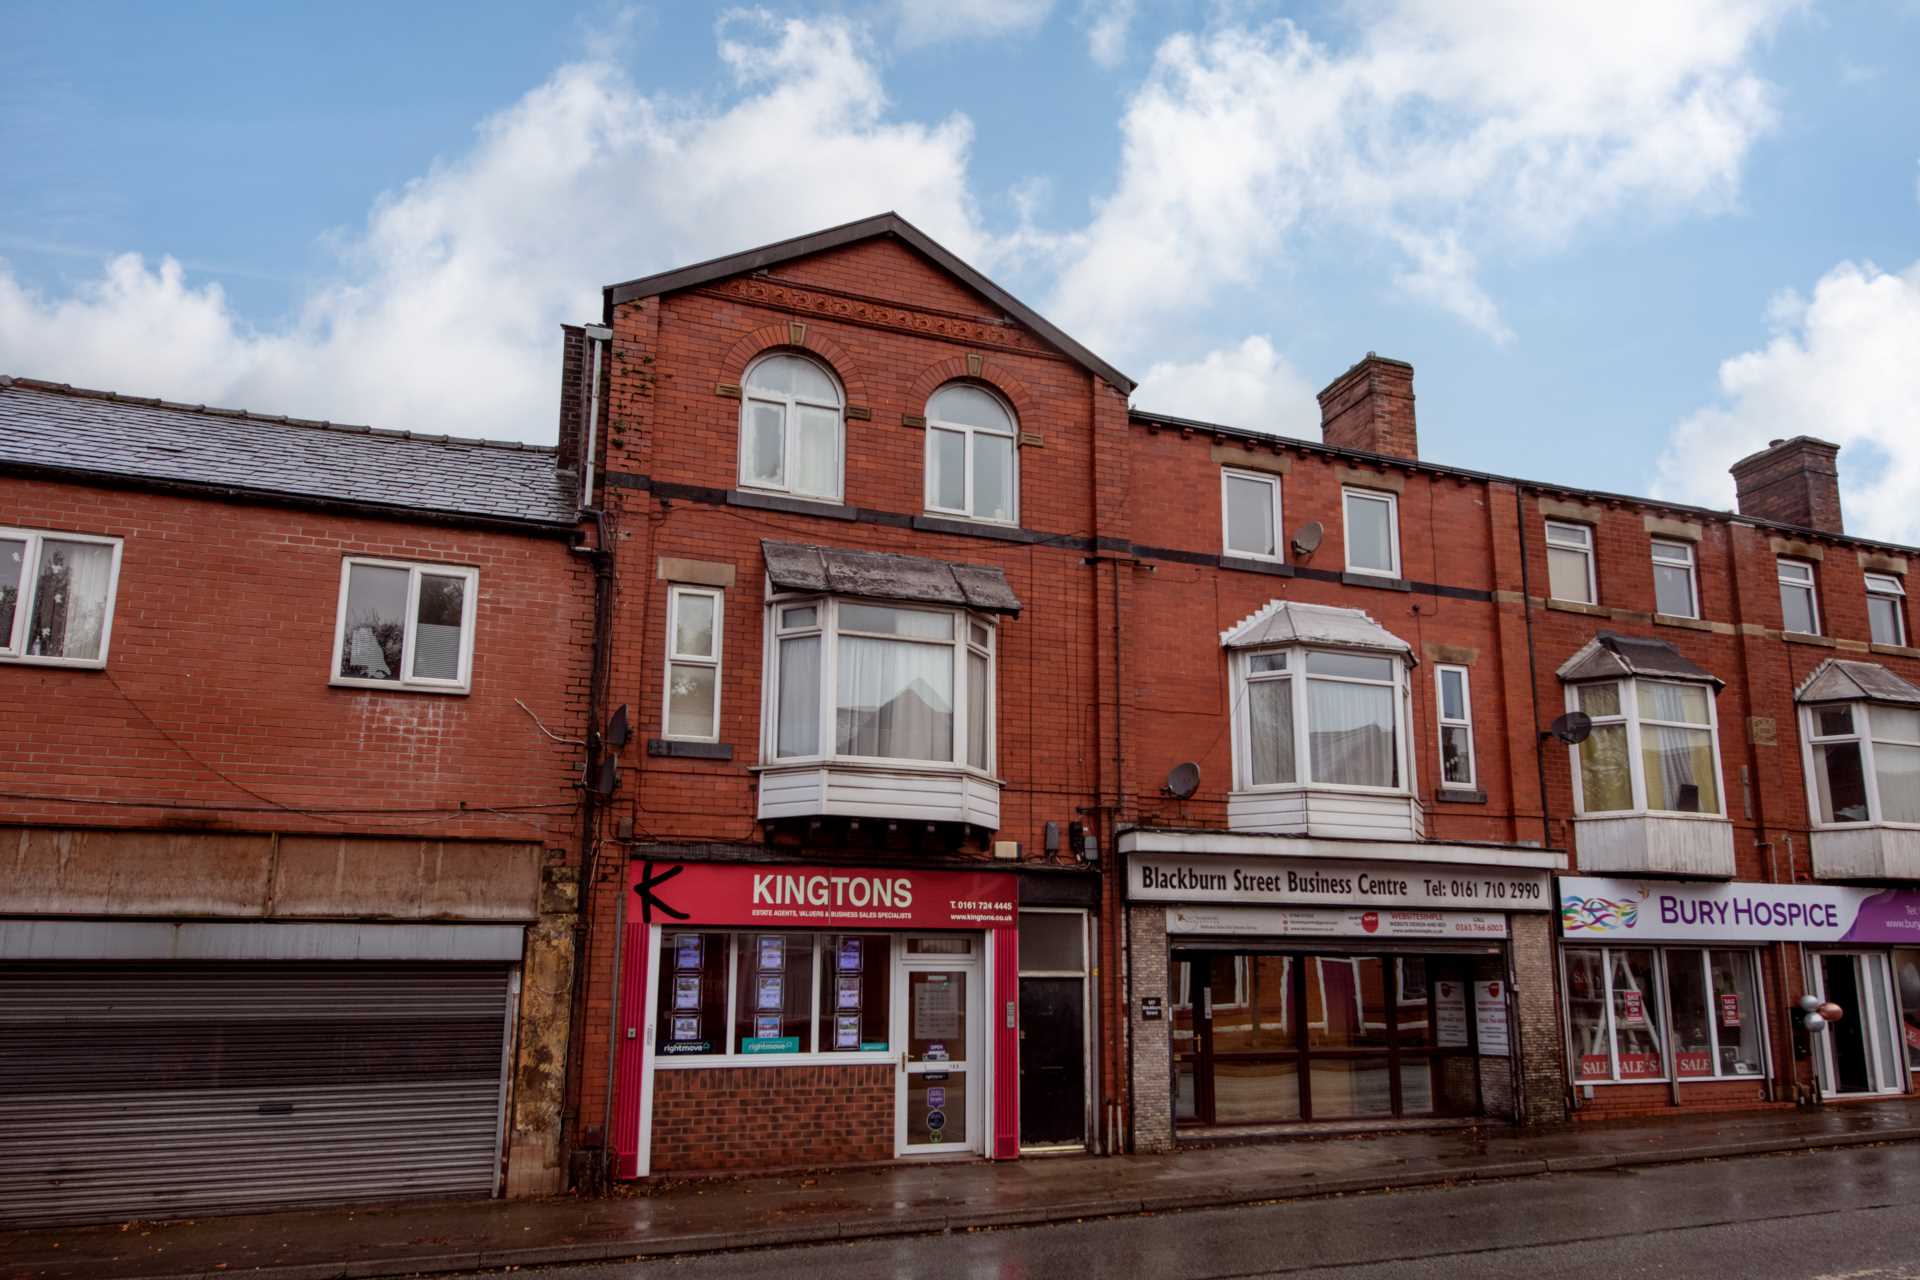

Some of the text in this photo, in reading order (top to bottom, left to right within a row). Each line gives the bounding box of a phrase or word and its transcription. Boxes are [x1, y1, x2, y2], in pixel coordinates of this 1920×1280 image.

[1142, 866, 1540, 899] Blackburn Street Business Centre Tel: 0161 710 2990
[753, 874, 913, 908] KINGTONS
[957, 901, 977, 910] 0161
[993, 902, 1013, 911] 4445
[1659, 895, 1839, 928] BURY HOSPICE
[752, 909, 773, 917] ESTATE
[798, 910, 824, 918] VALUERS
[830, 911, 858, 919] BUSINESS
[877, 912, 912, 920] SPECIALISTS
[950, 914, 1013, 922] www.kingtons.co.uk
[663, 1044, 703, 1055] rightmove
[1680, 1059, 1711, 1072] SALE
